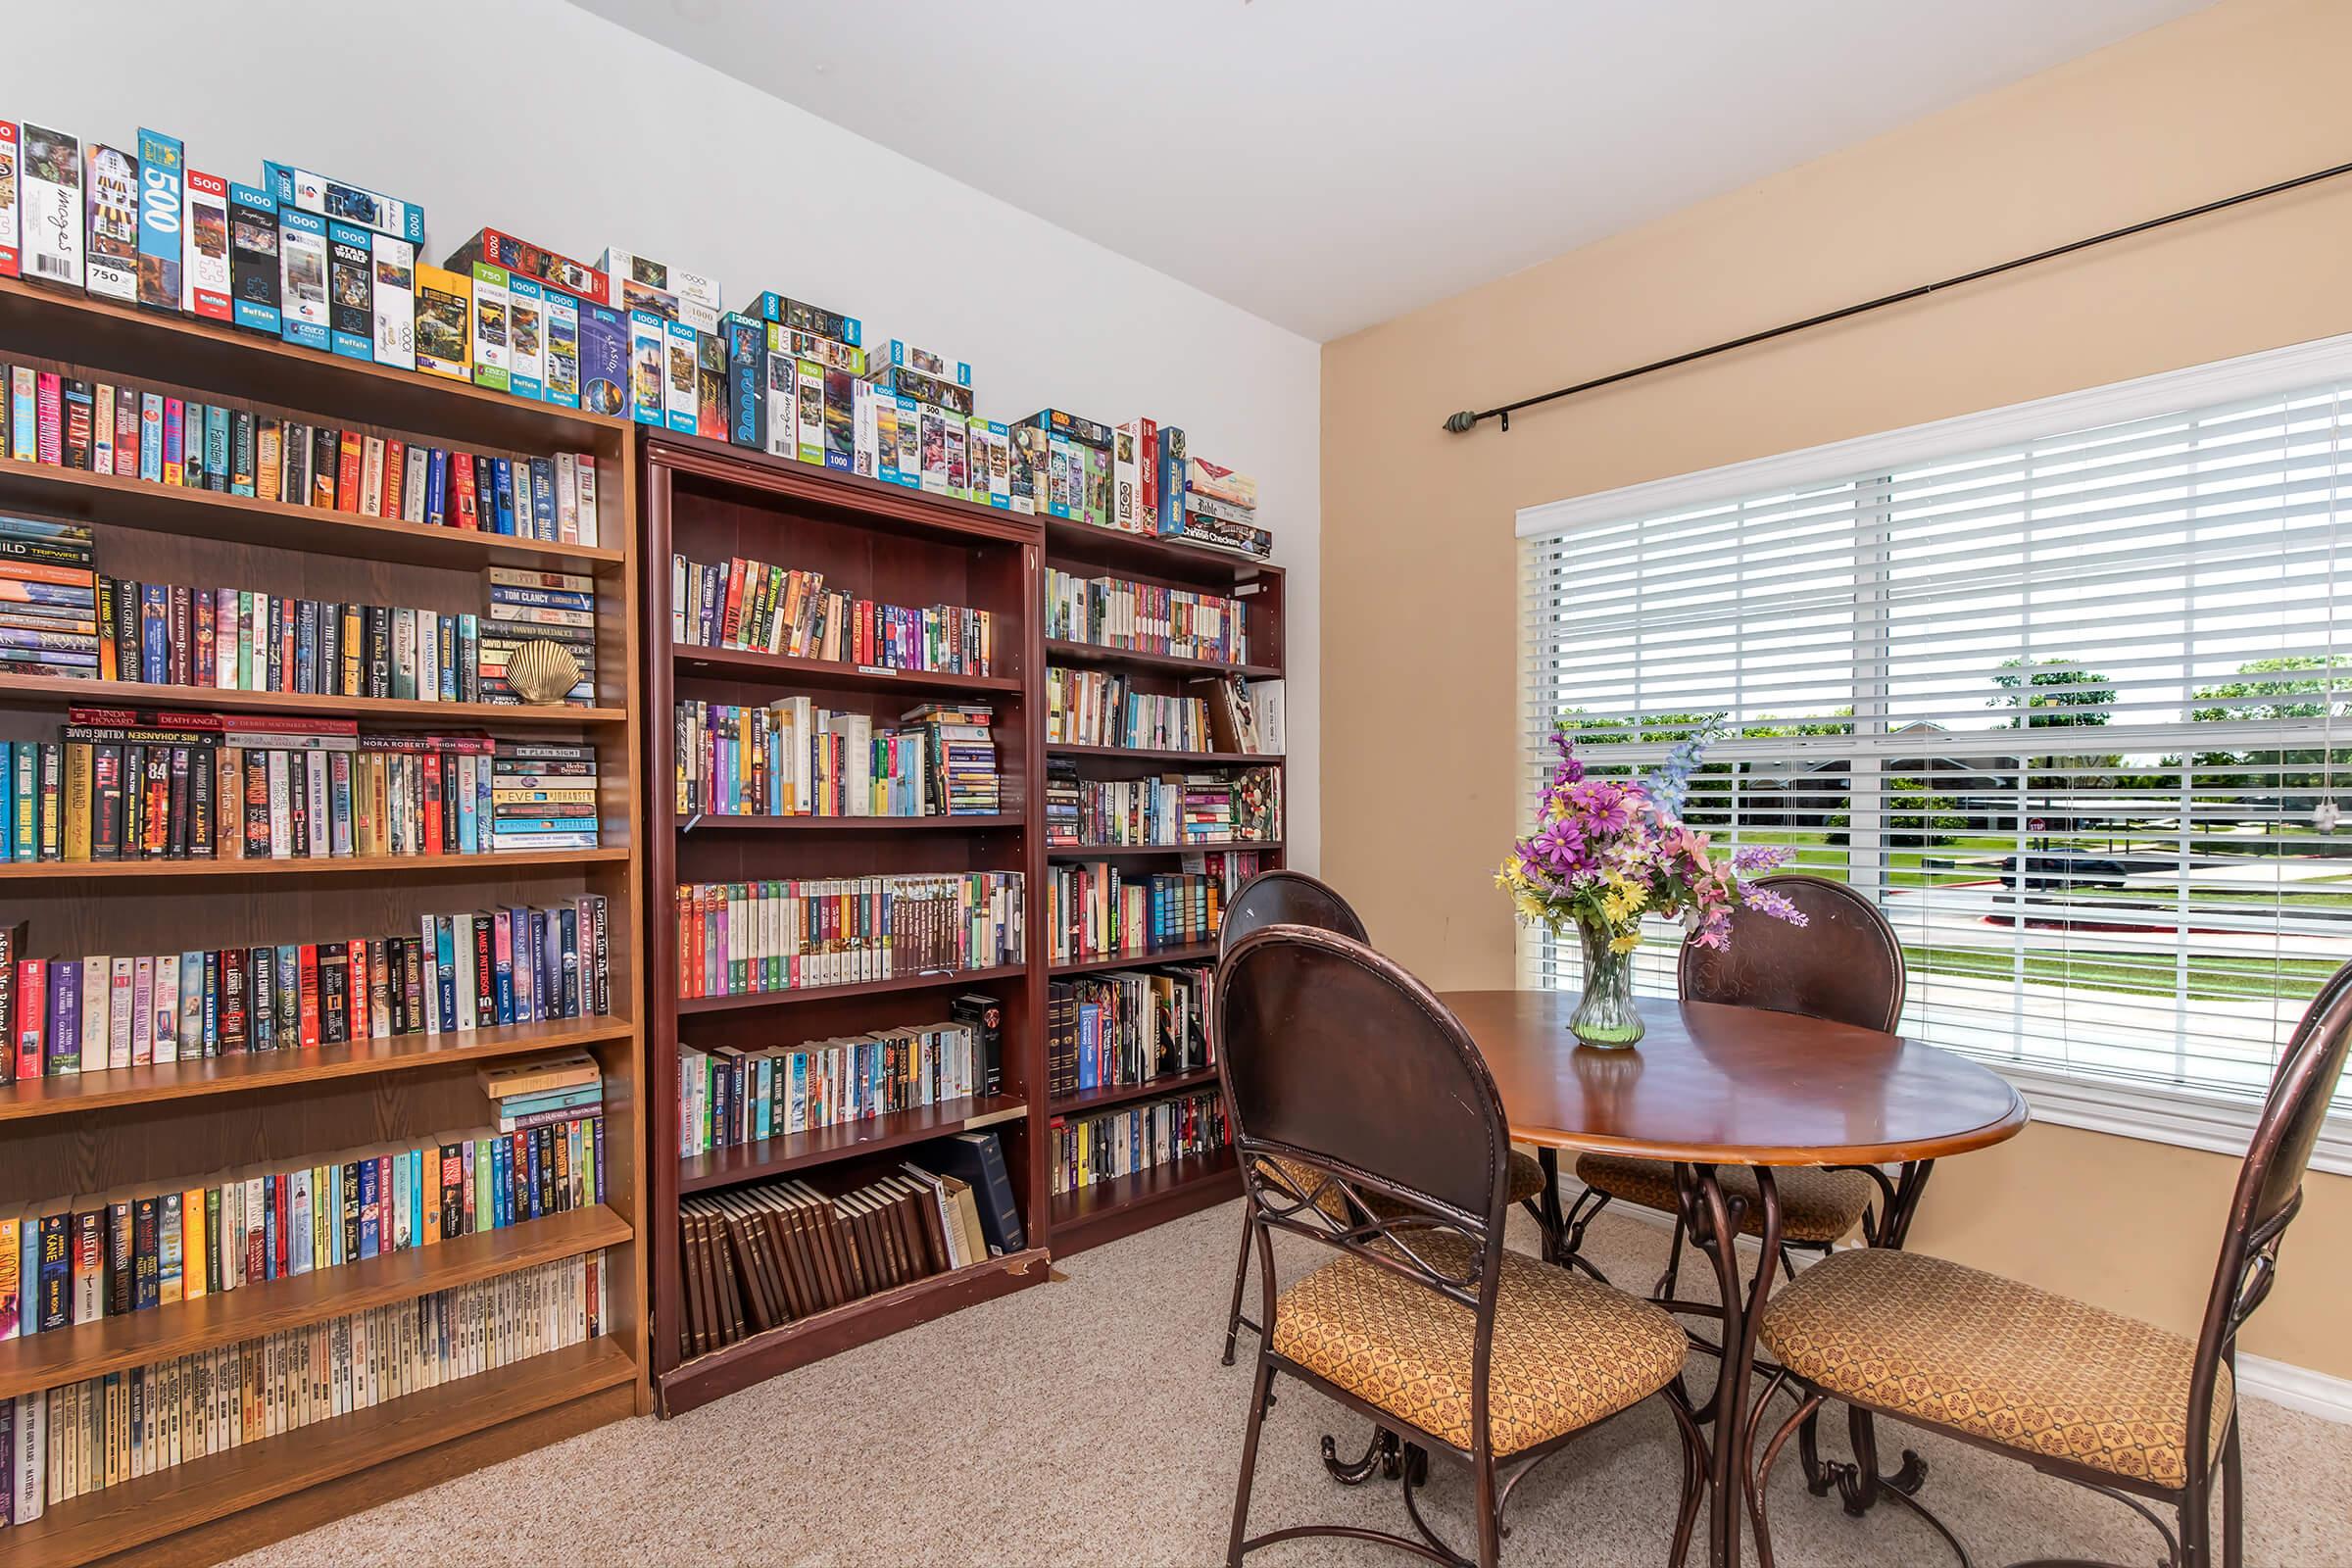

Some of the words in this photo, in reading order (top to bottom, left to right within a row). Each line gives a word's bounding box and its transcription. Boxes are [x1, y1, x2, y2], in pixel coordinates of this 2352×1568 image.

[193, 176, 221, 191] 500
[144, 167, 179, 233] 500
[238, 191, 271, 207] 1000
[46, 188, 73, 252] images
[287, 215, 318, 229] 1000
[410, 213, 419, 236] 1000
[336, 229, 366, 244] 1000
[334, 245, 365, 257] STAR
[490, 235, 499, 258] 1000
[335, 251, 368, 264] WARS
[92, 268, 119, 282] 750
[481, 270, 501, 281] 750
[512, 280, 536, 294] 1000
[550, 294, 573, 307] 1000
[242, 307, 274, 319] Buffalo
[637, 314, 659, 325] 1000
[692, 308, 713, 321] 1000
[672, 325, 693, 338] 1000
[338, 337, 368, 349] Buffalo
[606, 334, 619, 374] SEASIDE
[803, 365, 818, 374] 750
[513, 378, 537, 389] Buffalo
[877, 387, 894, 396] 1000
[39, 388, 59, 416] JANET
[552, 392, 572, 403] Buffalo
[898, 400, 913, 409] 1000
[780, 395, 793, 439] images
[926, 406, 940, 416] 500
[69, 405, 90, 448] FLINT
[236, 420, 248, 446] ALLISON
[990, 424, 1005, 433] 1000
[39, 416, 60, 463] EVANOVICH
[210, 428, 225, 466] Fairstein
[117, 450, 134, 476] SACRED
[236, 447, 248, 475] BRENNAN
[390, 452, 401, 471] JULIE
[830, 455, 848, 466] 1000
[1120, 483, 1130, 518] 1500
[1199, 498, 1218, 516] Bible
[1209, 532, 1240, 546] Checkers
[30, 548, 79, 560] TRIPWIRE
[101, 590, 111, 601] LEE
[122, 592, 133, 609] TIM
[504, 591, 520, 601] TOM
[521, 592, 549, 604] CLANCY
[757, 595, 765, 611] FALLS
[101, 600, 112, 621] HARRIS
[123, 609, 134, 638] GREEN
[177, 616, 187, 643] GRAFTON
[399, 621, 408, 636] THE
[514, 625, 536, 634] DAVID
[537, 627, 573, 638] BALDACCI
[726, 606, 740, 640] TAKEN
[40, 633, 70, 644] SPEAK
[73, 635, 94, 645] NO
[325, 625, 334, 640] THE
[325, 641, 334, 660] FIRM
[399, 636, 408, 663] PARTNER
[481, 639, 501, 649] DAVID
[425, 630, 434, 691] HUMMINGBIRD
[90, 715, 134, 725] HOWARD
[98, 710, 126, 718] LINDA
[161, 716, 193, 725] DEATH
[194, 717, 219, 726] ANGEL
[66, 727, 93, 738] GAME
[94, 729, 124, 740] KILLING
[127, 731, 179, 742] JOHANSEN
[181, 733, 199, 742] IRIS
[392, 741, 430, 750] ROBERTS
[20, 756, 31, 770] JACK
[45, 754, 58, 766] JACK
[73, 759, 85, 780] LINDA
[97, 757, 110, 789] HILL
[148, 761, 167, 780] 8.4
[196, 764, 207, 788] PARADISE
[248, 765, 267, 805] JOHANSEN
[336, 784, 347, 804] BLACK
[73, 781, 85, 808] HOWARD
[197, 789, 207, 802] LOST
[508, 792, 531, 801] EVE
[553, 792, 592, 801] JOHANSEN
[20, 799, 32, 826] THUNDER
[337, 803, 348, 823] WATER
[21, 826, 32, 844] POINT
[196, 817, 206, 843] JANCE
[516, 914, 525, 928] THIS
[477, 931, 487, 954] JAMES
[516, 928, 525, 954] PRESENT
[258, 959, 268, 979] RALPH
[282, 964, 293, 986] LINDA
[478, 955, 488, 996] PATTERSON
[226, 968, 238, 996] LASHNER
[301, 964, 318, 998] KRENTZ
[136, 987, 150, 1007] DEBBIE
[156, 982, 168, 1008] MACOMBER
[258, 979, 268, 1008] COMPTON
[283, 987, 294, 1016] HOWARD
[443, 984, 452, 1014] KINGSBURY
[227, 998, 240, 1015] FATAL
[135, 1008, 150, 1042] MACOMBER
[227, 1016, 240, 1033] FLAW
[327, 1010, 336, 1035] HEARING
[443, 1158, 453, 1186] KING
[46, 1234, 58, 1263] KANE
[82, 1231, 95, 1250] ALEX
[83, 1251, 95, 1270] KAVA
[116, 1243, 127, 1271] JOHANSEN
[50, 1280, 59, 1296] DARK
